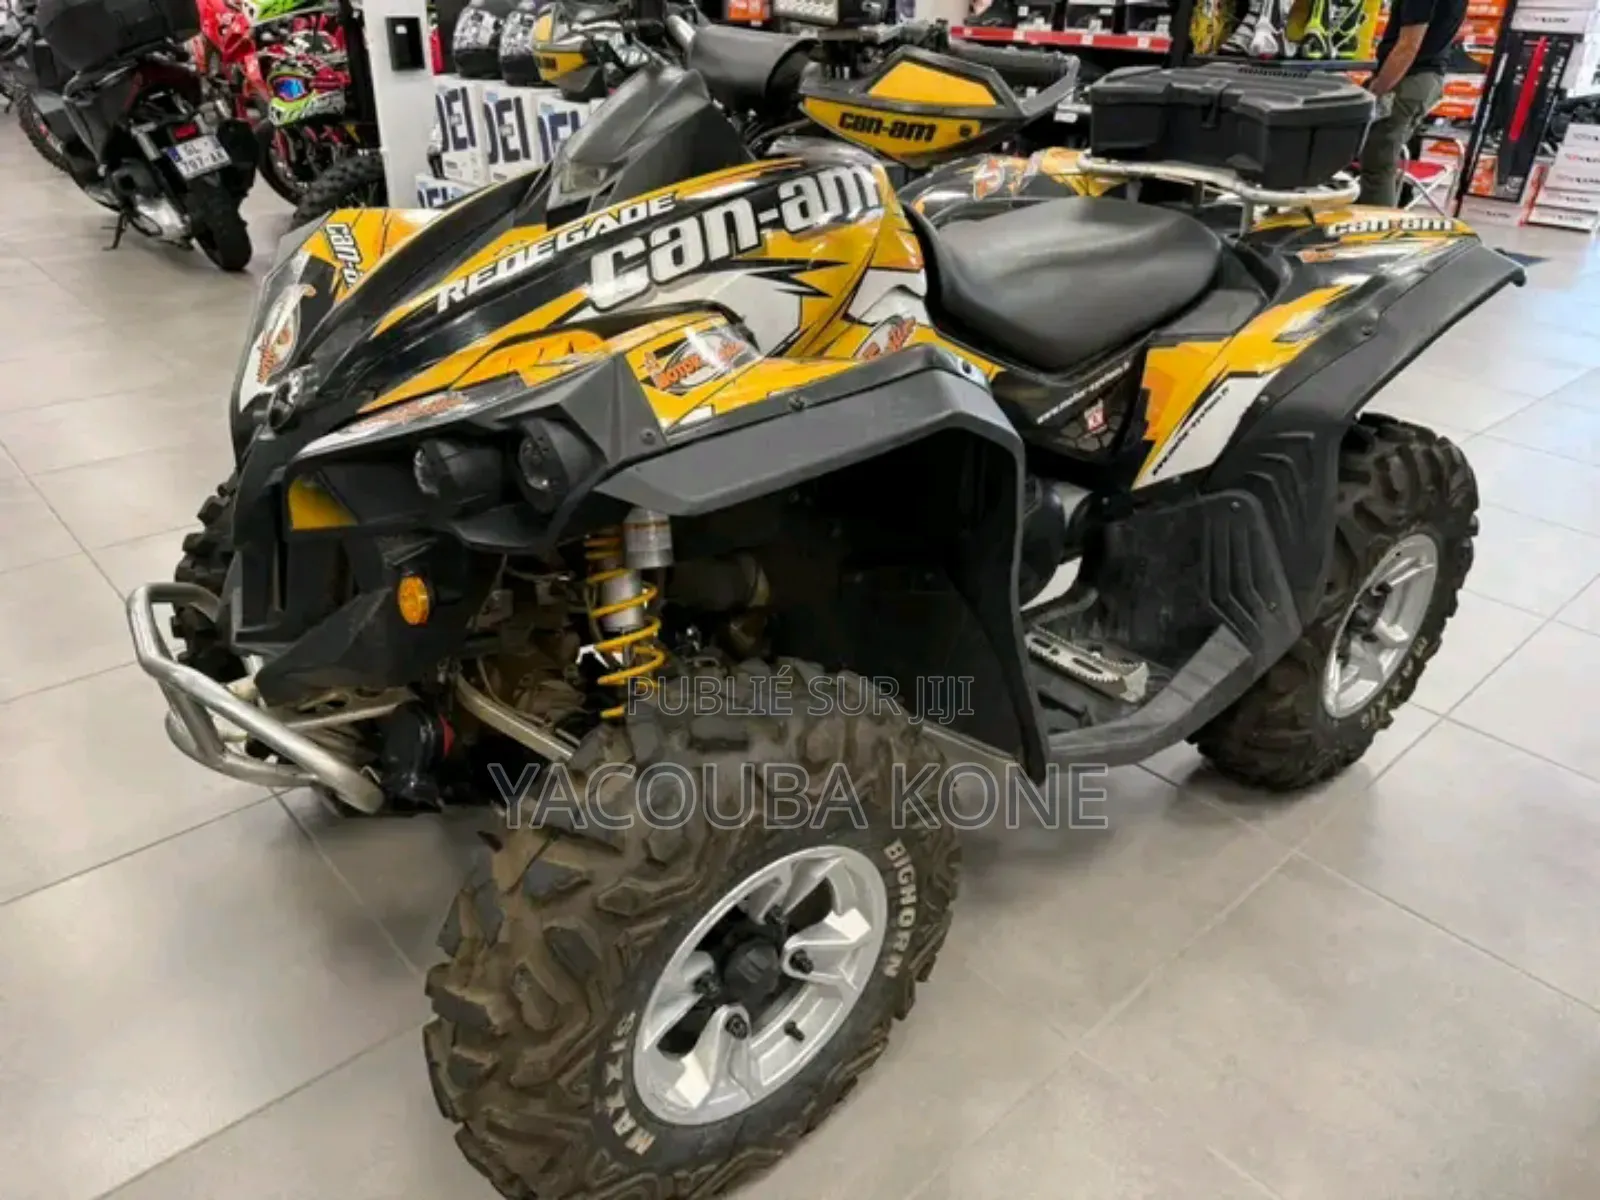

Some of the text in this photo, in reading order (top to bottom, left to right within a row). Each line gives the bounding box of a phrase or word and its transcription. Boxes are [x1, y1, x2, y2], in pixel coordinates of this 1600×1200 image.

[838, 112, 936, 143] can-am
[587, 165, 880, 311] can-am
[884, 838, 917, 978] BIGHORN
[606, 1011, 655, 1156] MAXXIS
